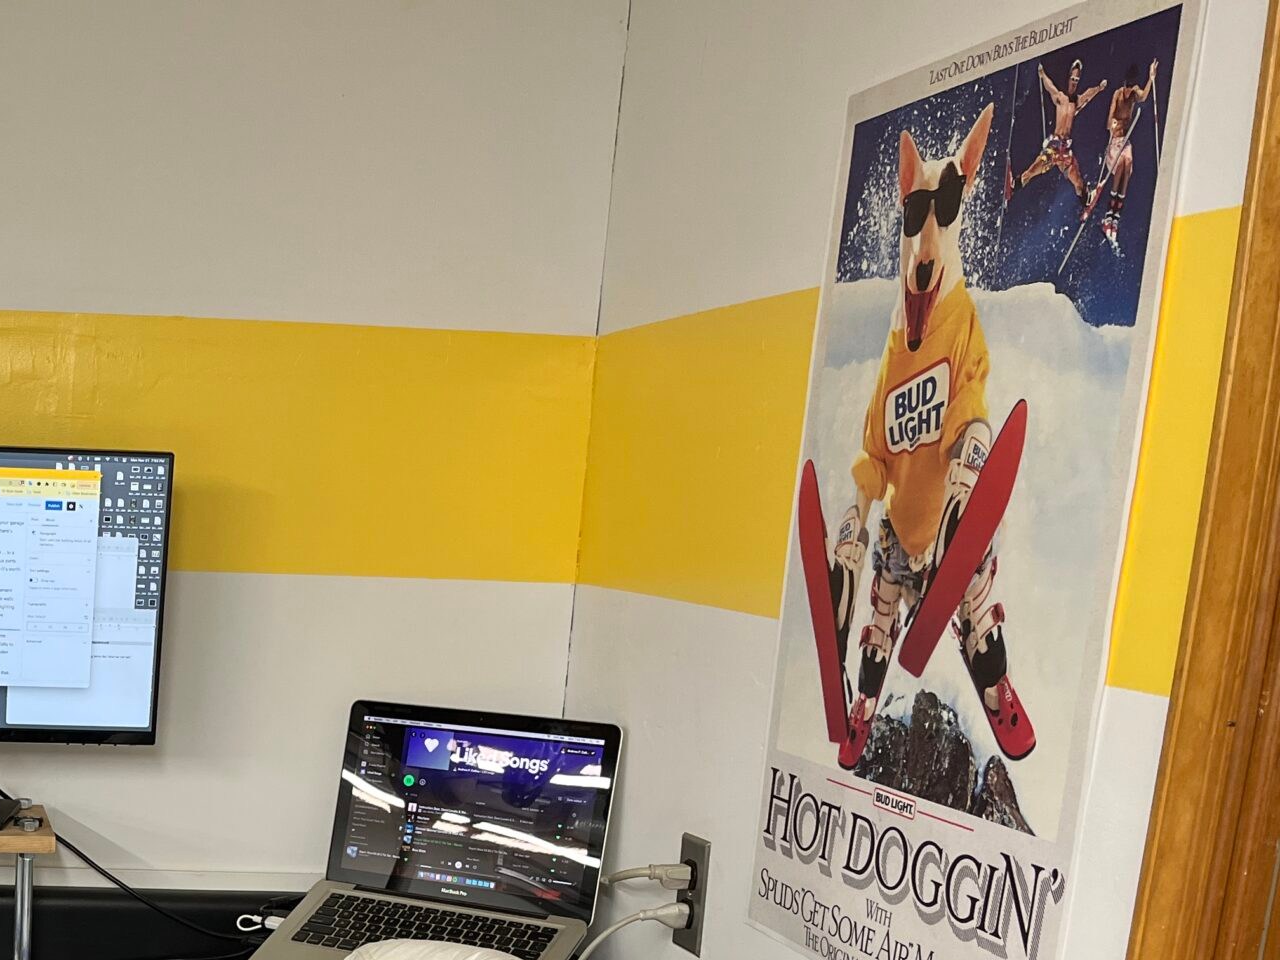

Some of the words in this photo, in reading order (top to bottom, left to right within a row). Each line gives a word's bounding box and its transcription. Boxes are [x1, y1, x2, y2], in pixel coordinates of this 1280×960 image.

[894, 376, 937, 421] BUD
[763, 767, 843, 866] HOT
[876, 792, 890, 806] BUD
[891, 798, 913, 815] LIGHT
[758, 868, 800, 915] SPUDS
[828, 905, 876, 956] SOME
[866, 898, 892, 928] WITH
[804, 925, 820, 952] THE
